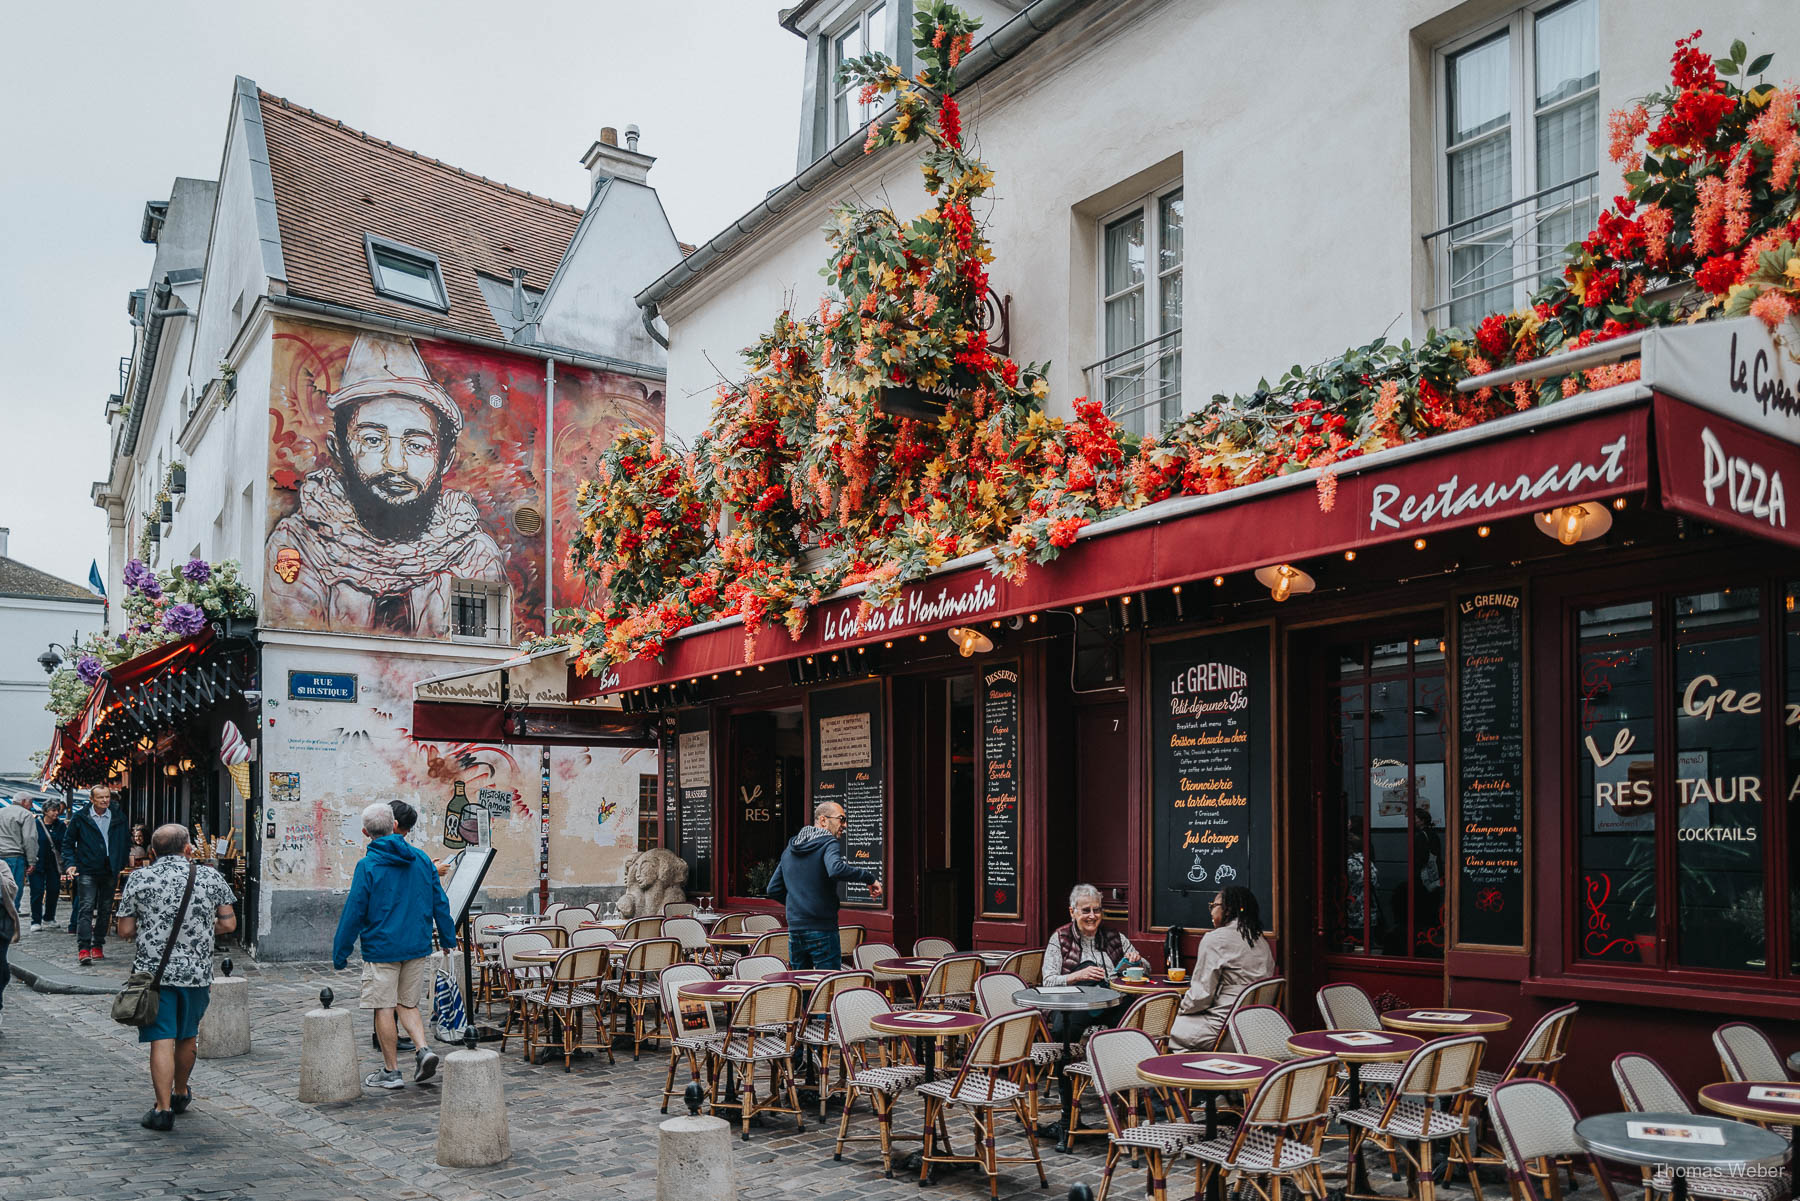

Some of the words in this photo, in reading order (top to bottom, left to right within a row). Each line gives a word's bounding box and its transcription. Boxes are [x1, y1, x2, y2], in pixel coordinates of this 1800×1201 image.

[1370, 434, 1627, 531] Restaurant
[1701, 426, 1786, 528] PIZZA
[889, 604, 904, 629] de
[907, 579, 996, 624] Montmartre
[1460, 600, 1474, 614] LE
[1474, 593, 1520, 609] GRENIER
[313, 678, 333, 687] RUE
[600, 666, 620, 691] Bar
[985, 670, 1017, 687] DESSERTS
[1171, 673, 1184, 695] LE
[1187, 662, 1247, 693] GRENIER
[306, 687, 348, 697] RUSTIQUE
[1113, 719, 1119, 732] 7
[1584, 728, 1636, 767] Le
[1180, 777, 1233, 791] Viennoiserie
[1373, 774, 1408, 789] Welcome
[480, 789, 512, 804] HISTOIRE
[1596, 780, 1653, 807] RES
[1676, 776, 1762, 804] TAUR
[480, 799, 511, 813] D'AMOUR
[1174, 799, 1186, 808] ou
[745, 808, 770, 821] RES
[1465, 823, 1518, 837] Champagnes
[1677, 828, 1757, 841] COCKTAILS
[1182, 829, 1200, 849] Jus
[1200, 829, 1239, 849] d'orange
